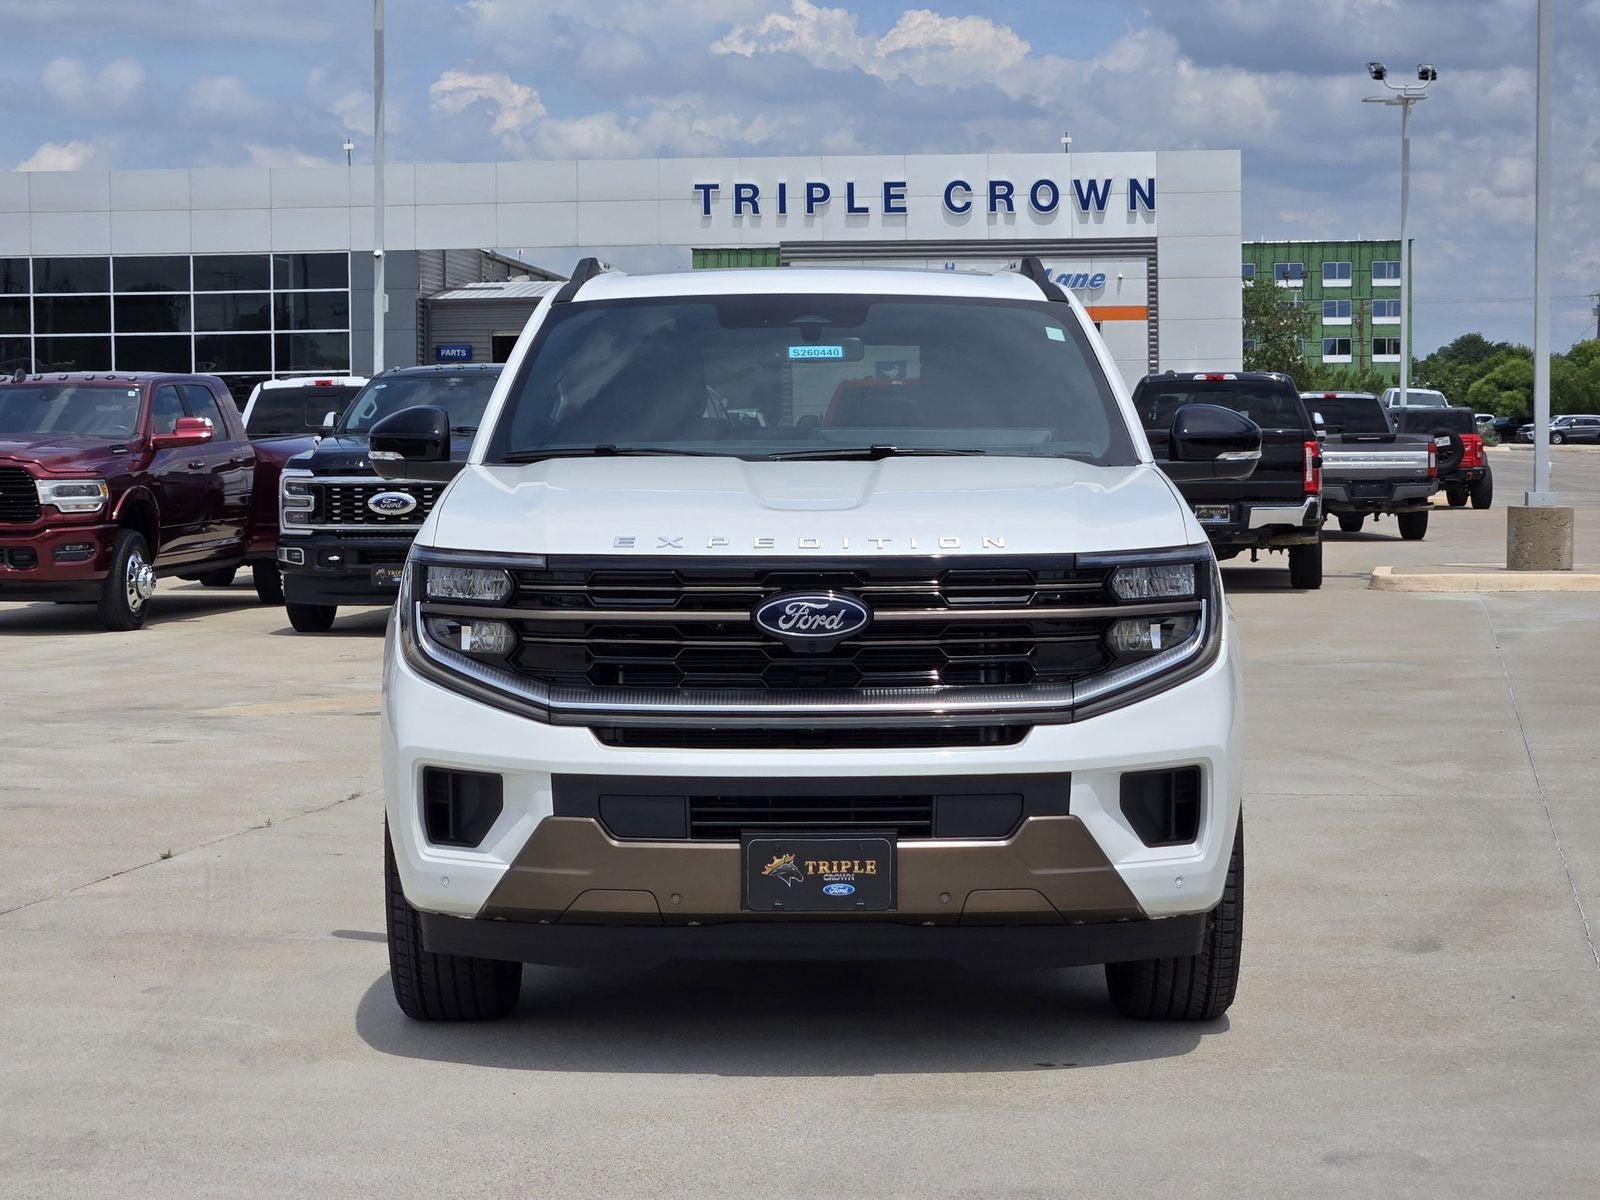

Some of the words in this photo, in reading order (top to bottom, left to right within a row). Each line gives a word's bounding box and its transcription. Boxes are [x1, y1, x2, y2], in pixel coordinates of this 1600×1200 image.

[693, 181, 908, 216] TRIPLE
[943, 177, 1156, 214] CROWN
[1044, 267, 1106, 290] ane
[440, 349, 467, 357] PARTS
[792, 348, 840, 357] S260440
[612, 535, 1007, 549] EXPEDITION
[778, 601, 846, 630] Ford
[804, 860, 877, 875] TRIPLE
[823, 873, 855, 882] CROWN
